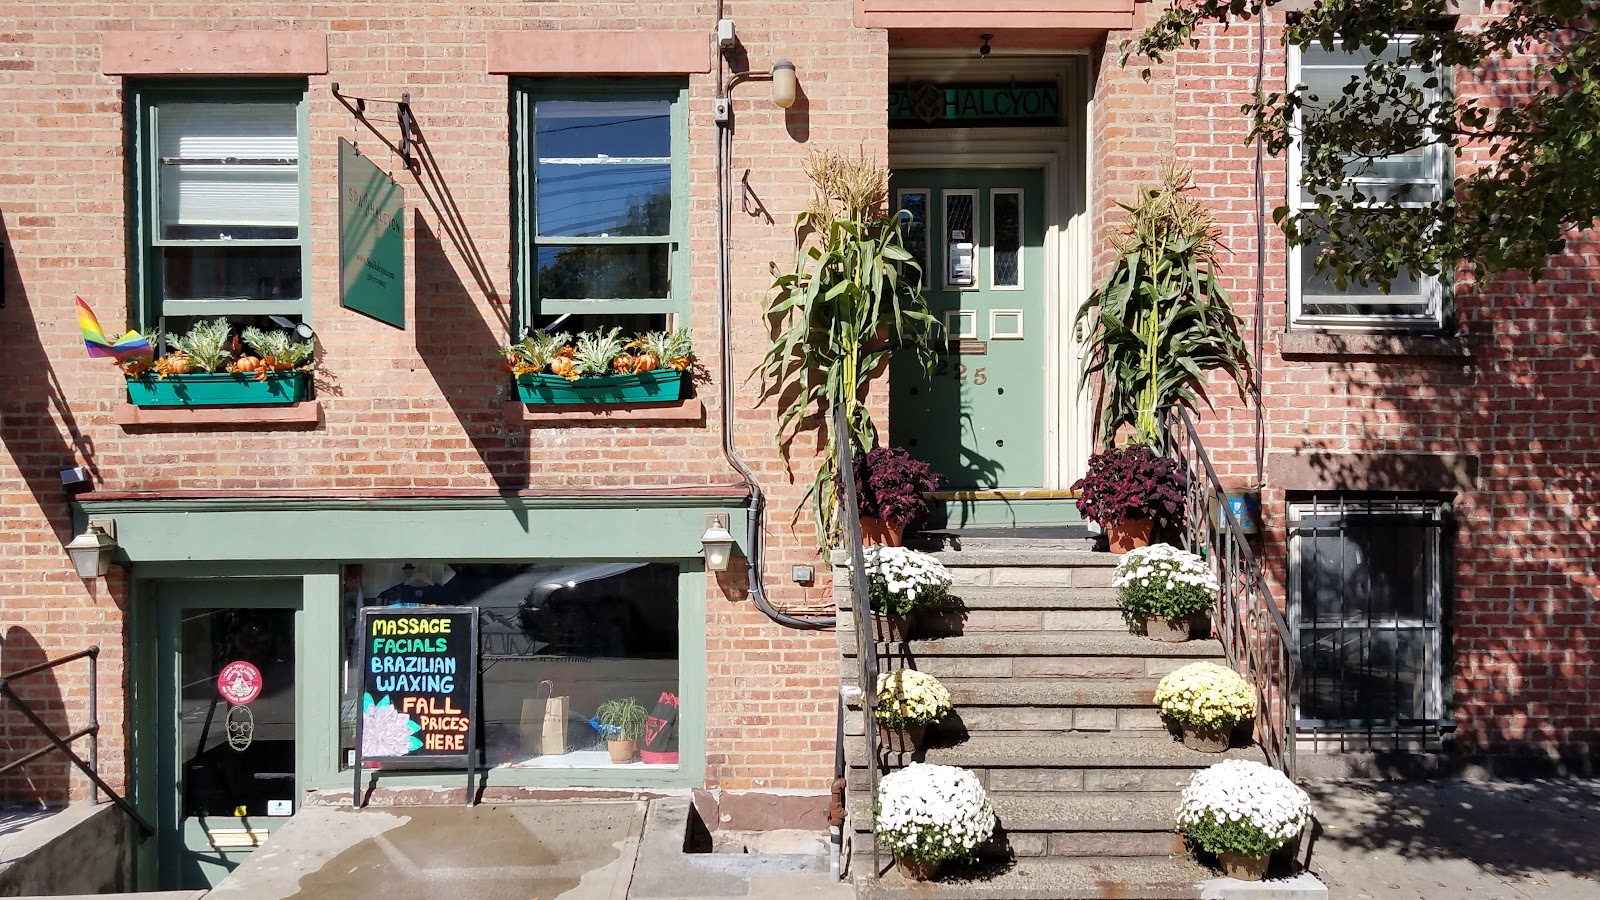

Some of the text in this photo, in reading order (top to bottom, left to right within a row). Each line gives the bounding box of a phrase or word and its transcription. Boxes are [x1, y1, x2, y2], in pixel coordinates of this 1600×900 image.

[943, 90, 1059, 117] HALCYON
[372, 617, 452, 636] MASSAGE
[373, 637, 448, 654] FACIALS
[371, 655, 456, 674] BRAZILIAN
[376, 674, 455, 694] WAXING
[402, 696, 462, 714] FALL
[420, 715, 470, 732] PRICES
[425, 733, 465, 751] HERE
